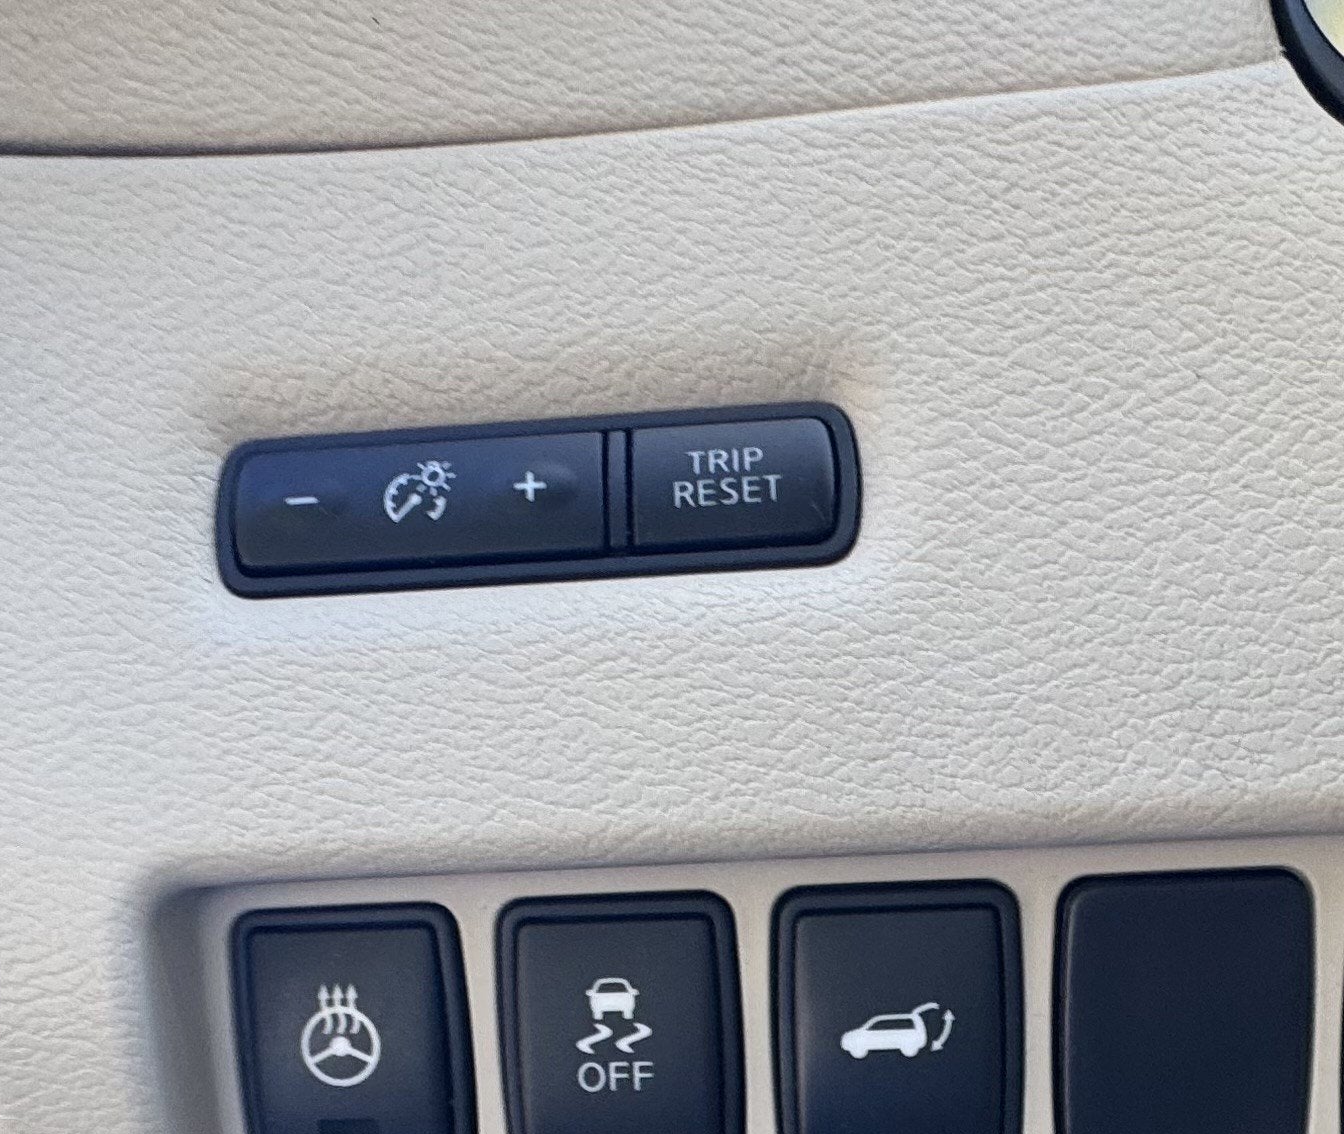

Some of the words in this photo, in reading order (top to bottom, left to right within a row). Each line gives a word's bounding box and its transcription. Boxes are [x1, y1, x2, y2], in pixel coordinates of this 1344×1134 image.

[685, 446, 764, 475] TRIP
[672, 474, 783, 509] RESET
[577, 1061, 654, 1092] OFF
